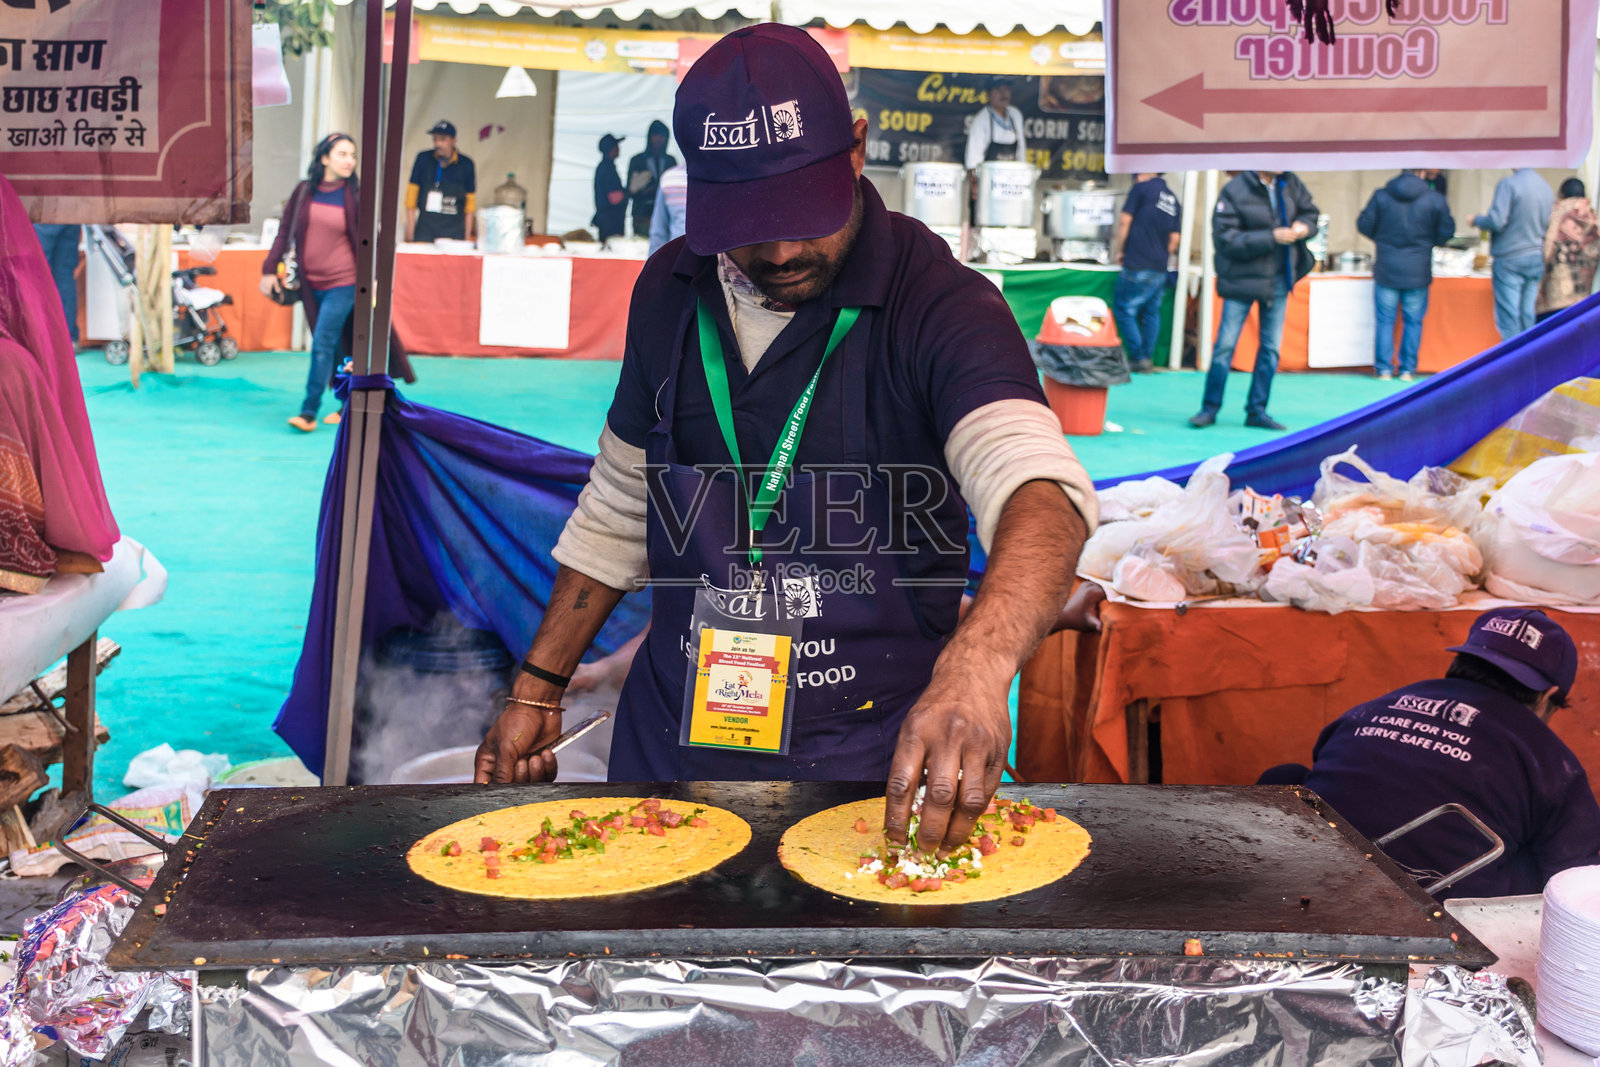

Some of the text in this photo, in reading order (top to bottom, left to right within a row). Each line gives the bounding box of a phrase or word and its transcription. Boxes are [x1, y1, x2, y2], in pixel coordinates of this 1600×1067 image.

[32, 39, 107, 71] साग
[3, 86, 62, 113] छाछ
[7, 118, 146, 147] खाओ दिल से
[699, 109, 760, 150] fssai
[879, 109, 933, 133] SOUP
[1024, 118, 1105, 141] CORN SOU
[866, 140, 943, 162] UR SOUP
[766, 396, 809, 491] National Street Food
[792, 638, 835, 658] YOU
[796, 665, 856, 688] FOOD
[724, 716, 749, 725] VENDOR
[1379, 715, 1412, 728] CARE
[1412, 721, 1440, 735] FOR
[1442, 729, 1471, 745] YOU
[1359, 726, 1400, 741] SERVE
[1400, 733, 1433, 750] SAFE
[1433, 742, 1472, 762] FOOD
